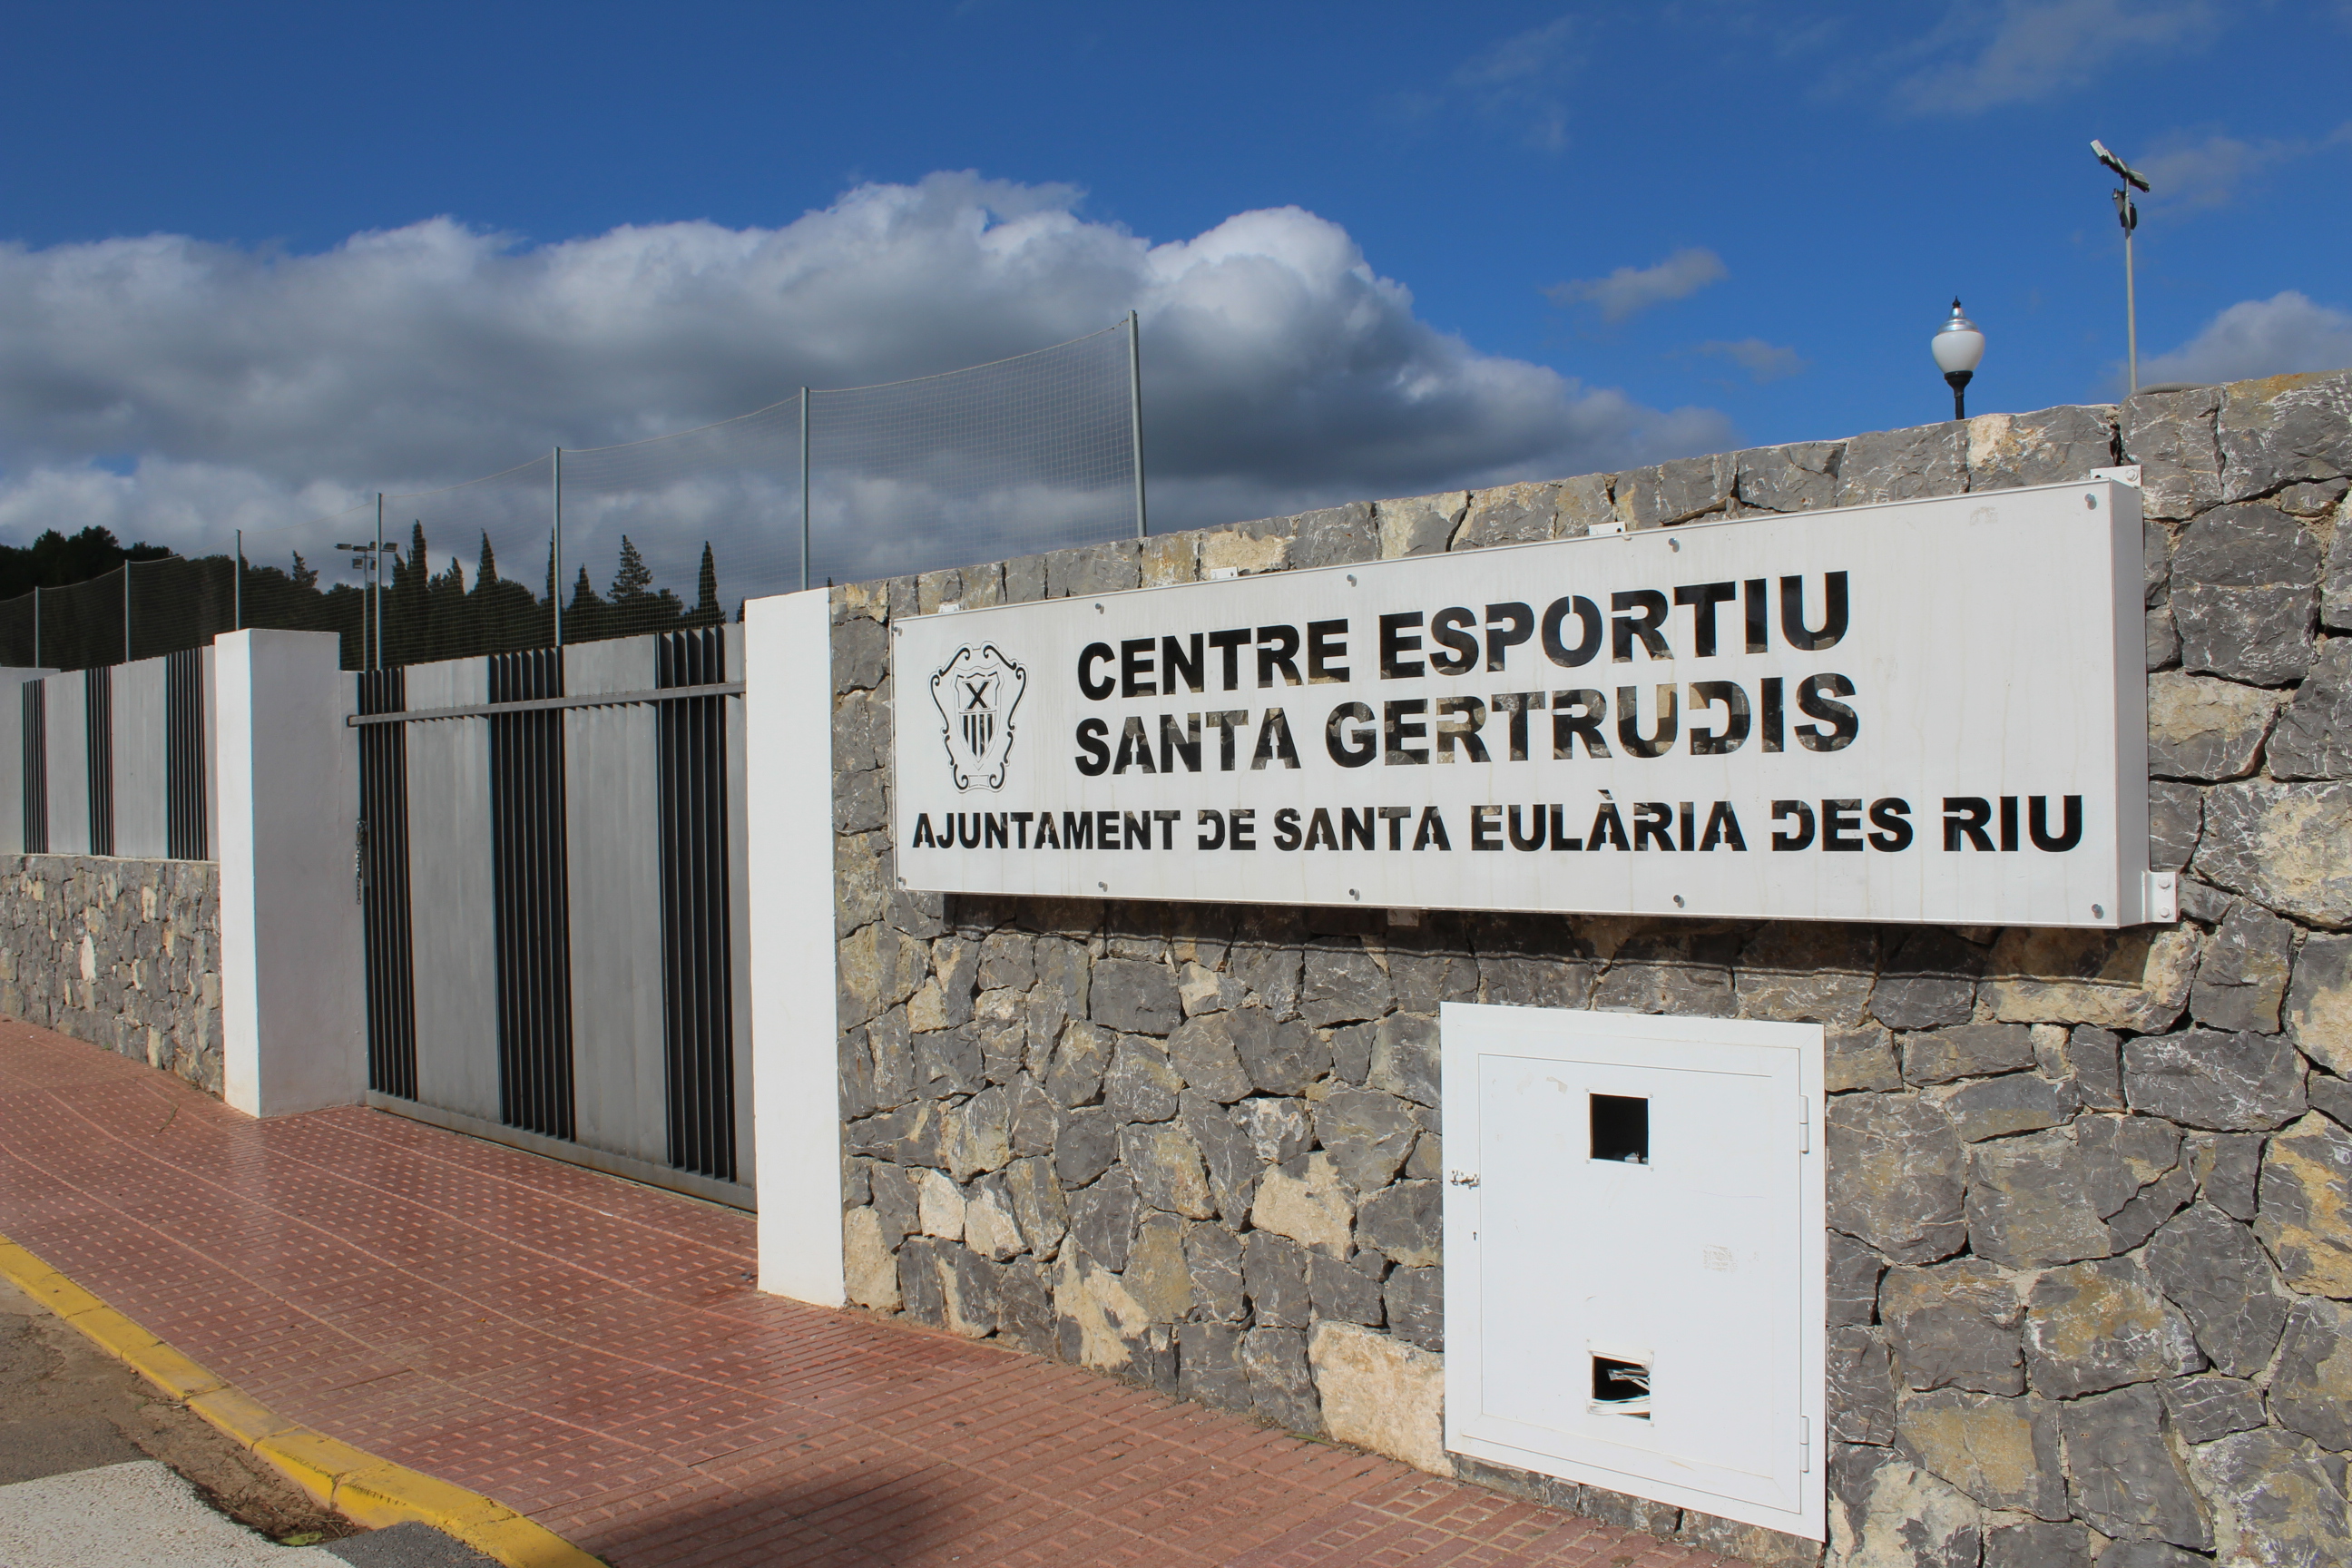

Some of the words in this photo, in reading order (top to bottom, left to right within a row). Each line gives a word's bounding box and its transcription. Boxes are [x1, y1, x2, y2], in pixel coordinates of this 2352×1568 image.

[1077, 618, 1350, 701] CENTRE
[1378, 570, 1849, 681] ESPORTIU
[1074, 707, 1302, 777] SANTA
[1325, 672, 1859, 769] GERTRUDIS
[912, 809, 1181, 850] AJUNTAMENT
[1197, 808, 1257, 851] DE
[1273, 806, 1452, 852] SANTA
[1470, 789, 1748, 852] EULÀRIA
[1771, 797, 1914, 853] DES
[1943, 794, 2082, 853] RIU
